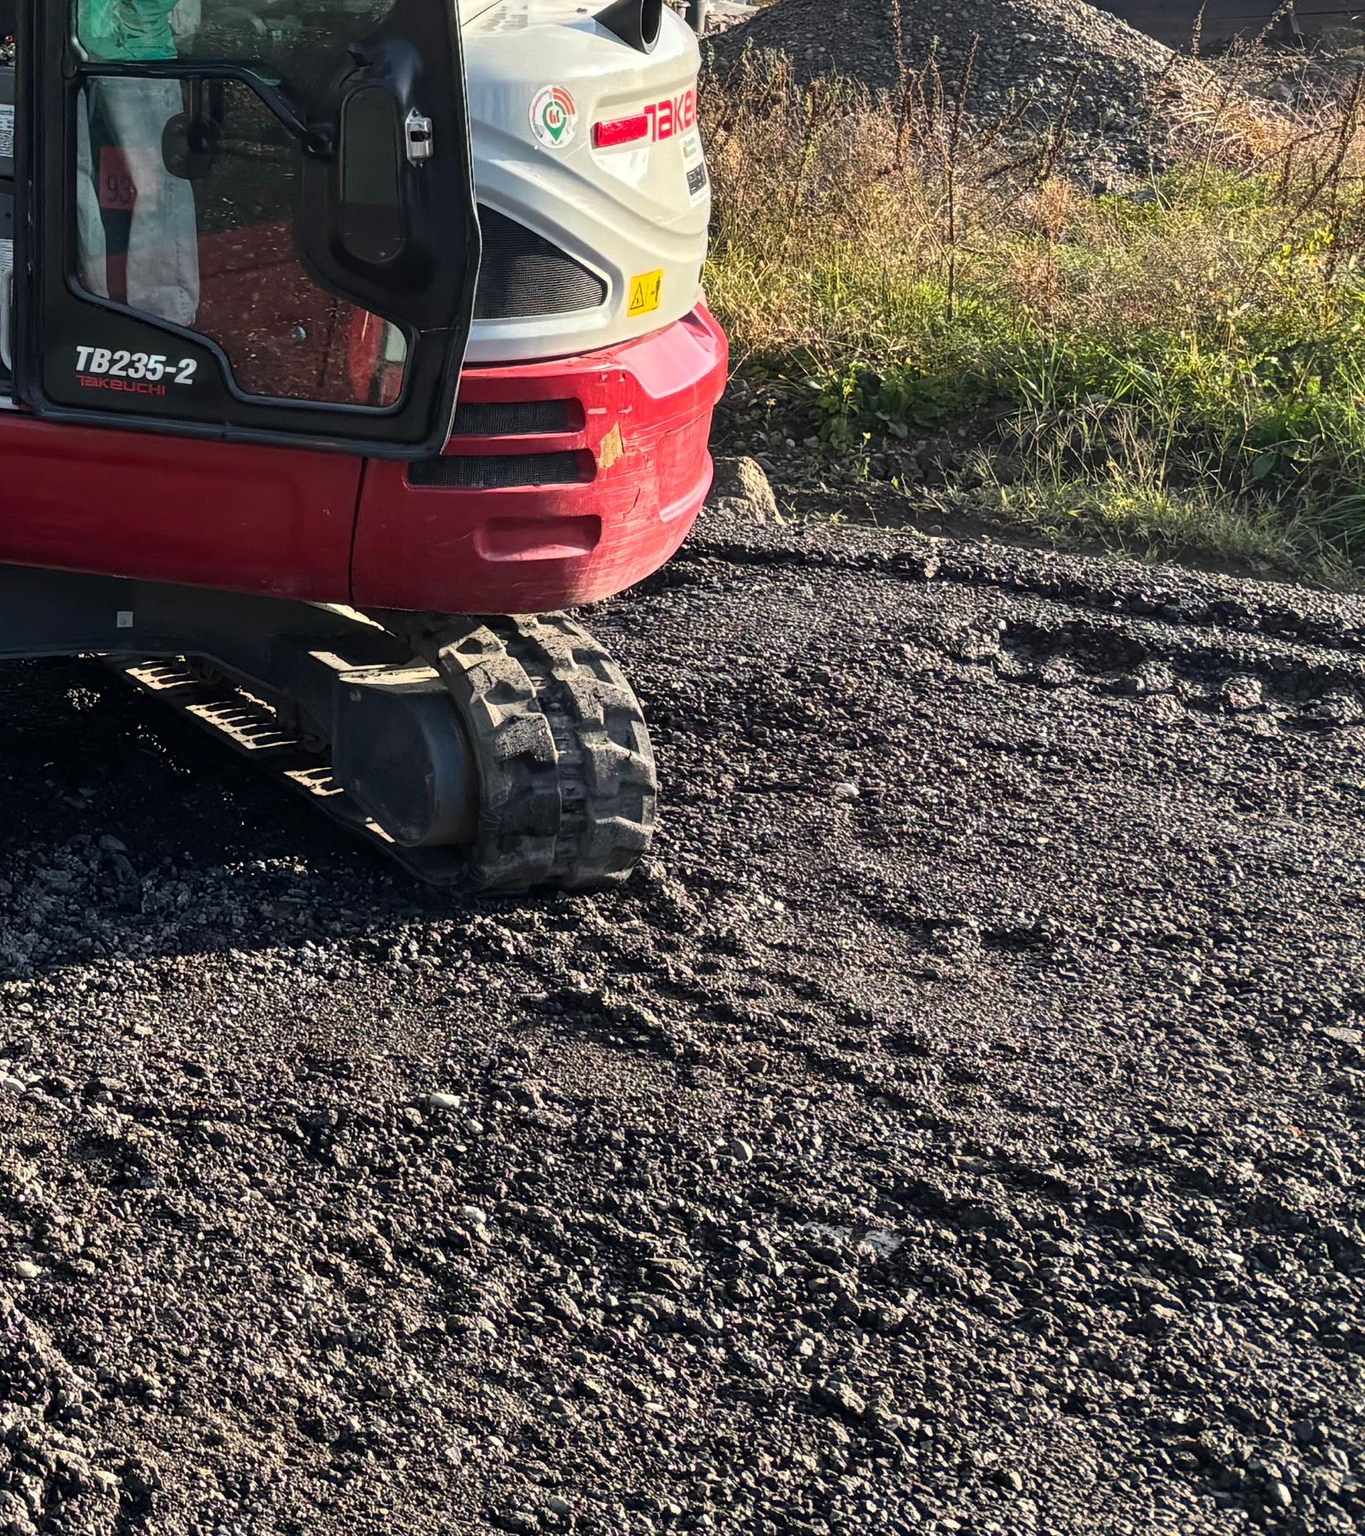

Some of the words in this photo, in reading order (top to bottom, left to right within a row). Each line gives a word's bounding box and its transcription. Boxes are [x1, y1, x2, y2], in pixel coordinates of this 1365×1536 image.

[644, 90, 695, 142] TAKE
[76, 345, 198, 385] TB235-2
[76, 375, 166, 396] TAKEUCHI
